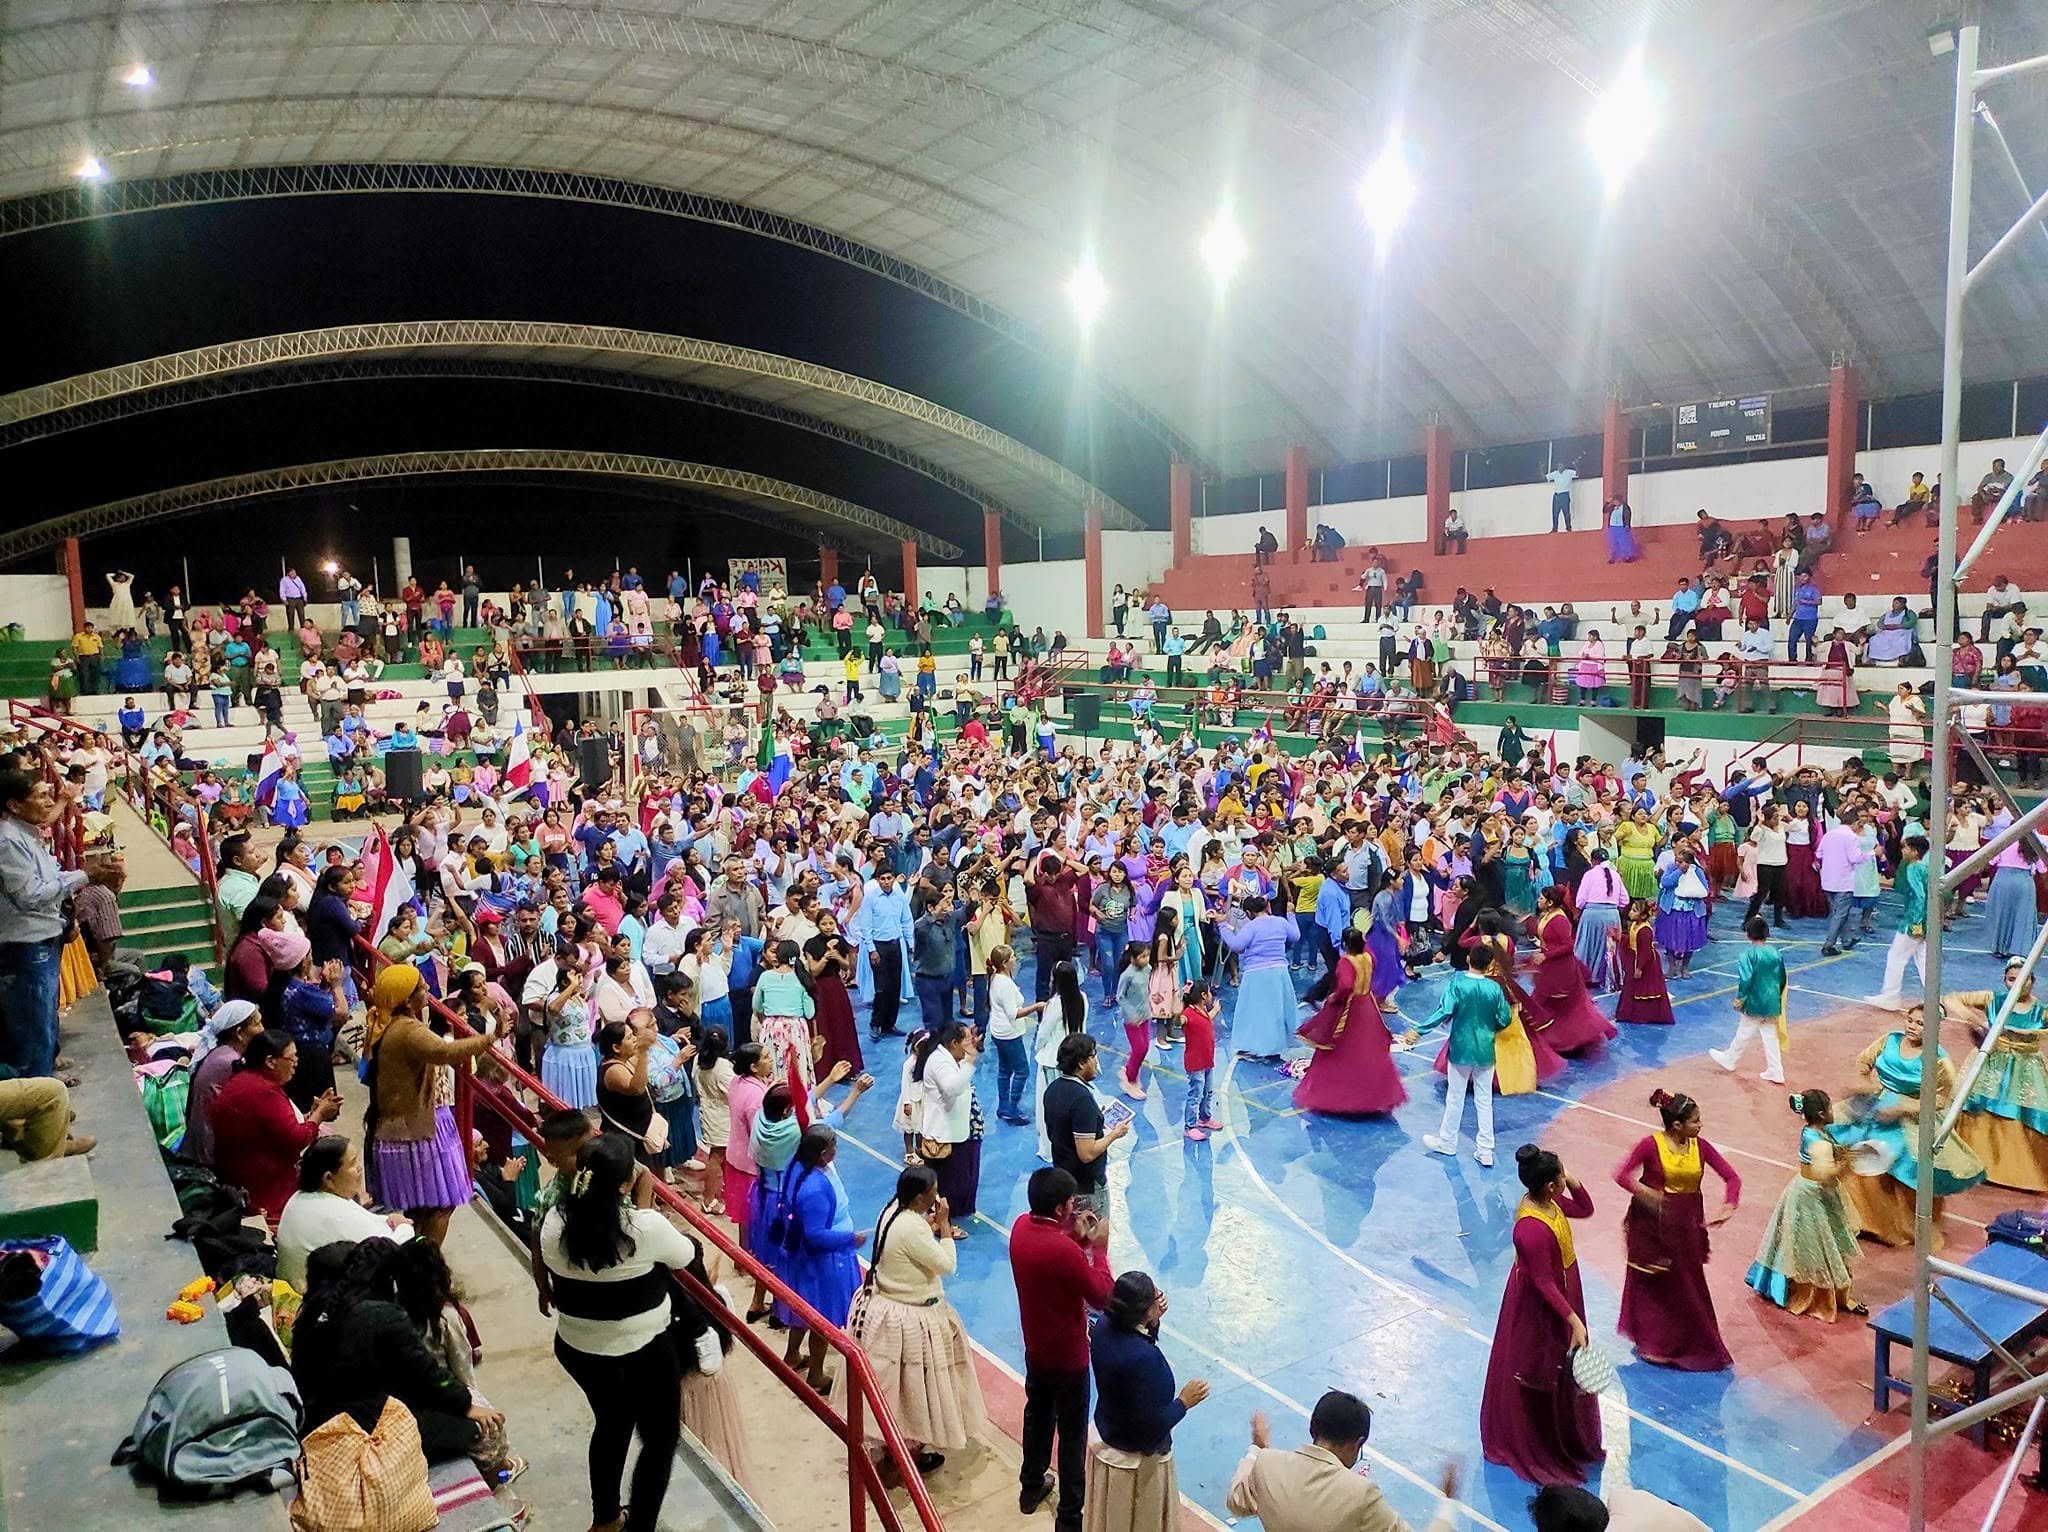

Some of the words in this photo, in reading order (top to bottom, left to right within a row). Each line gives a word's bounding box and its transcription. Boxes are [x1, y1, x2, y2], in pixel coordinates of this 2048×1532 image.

[1708, 400, 1736, 408] TIEMPO
[1744, 409, 1764, 417] VISITA
[1745, 433, 1766, 442] FALTAS
